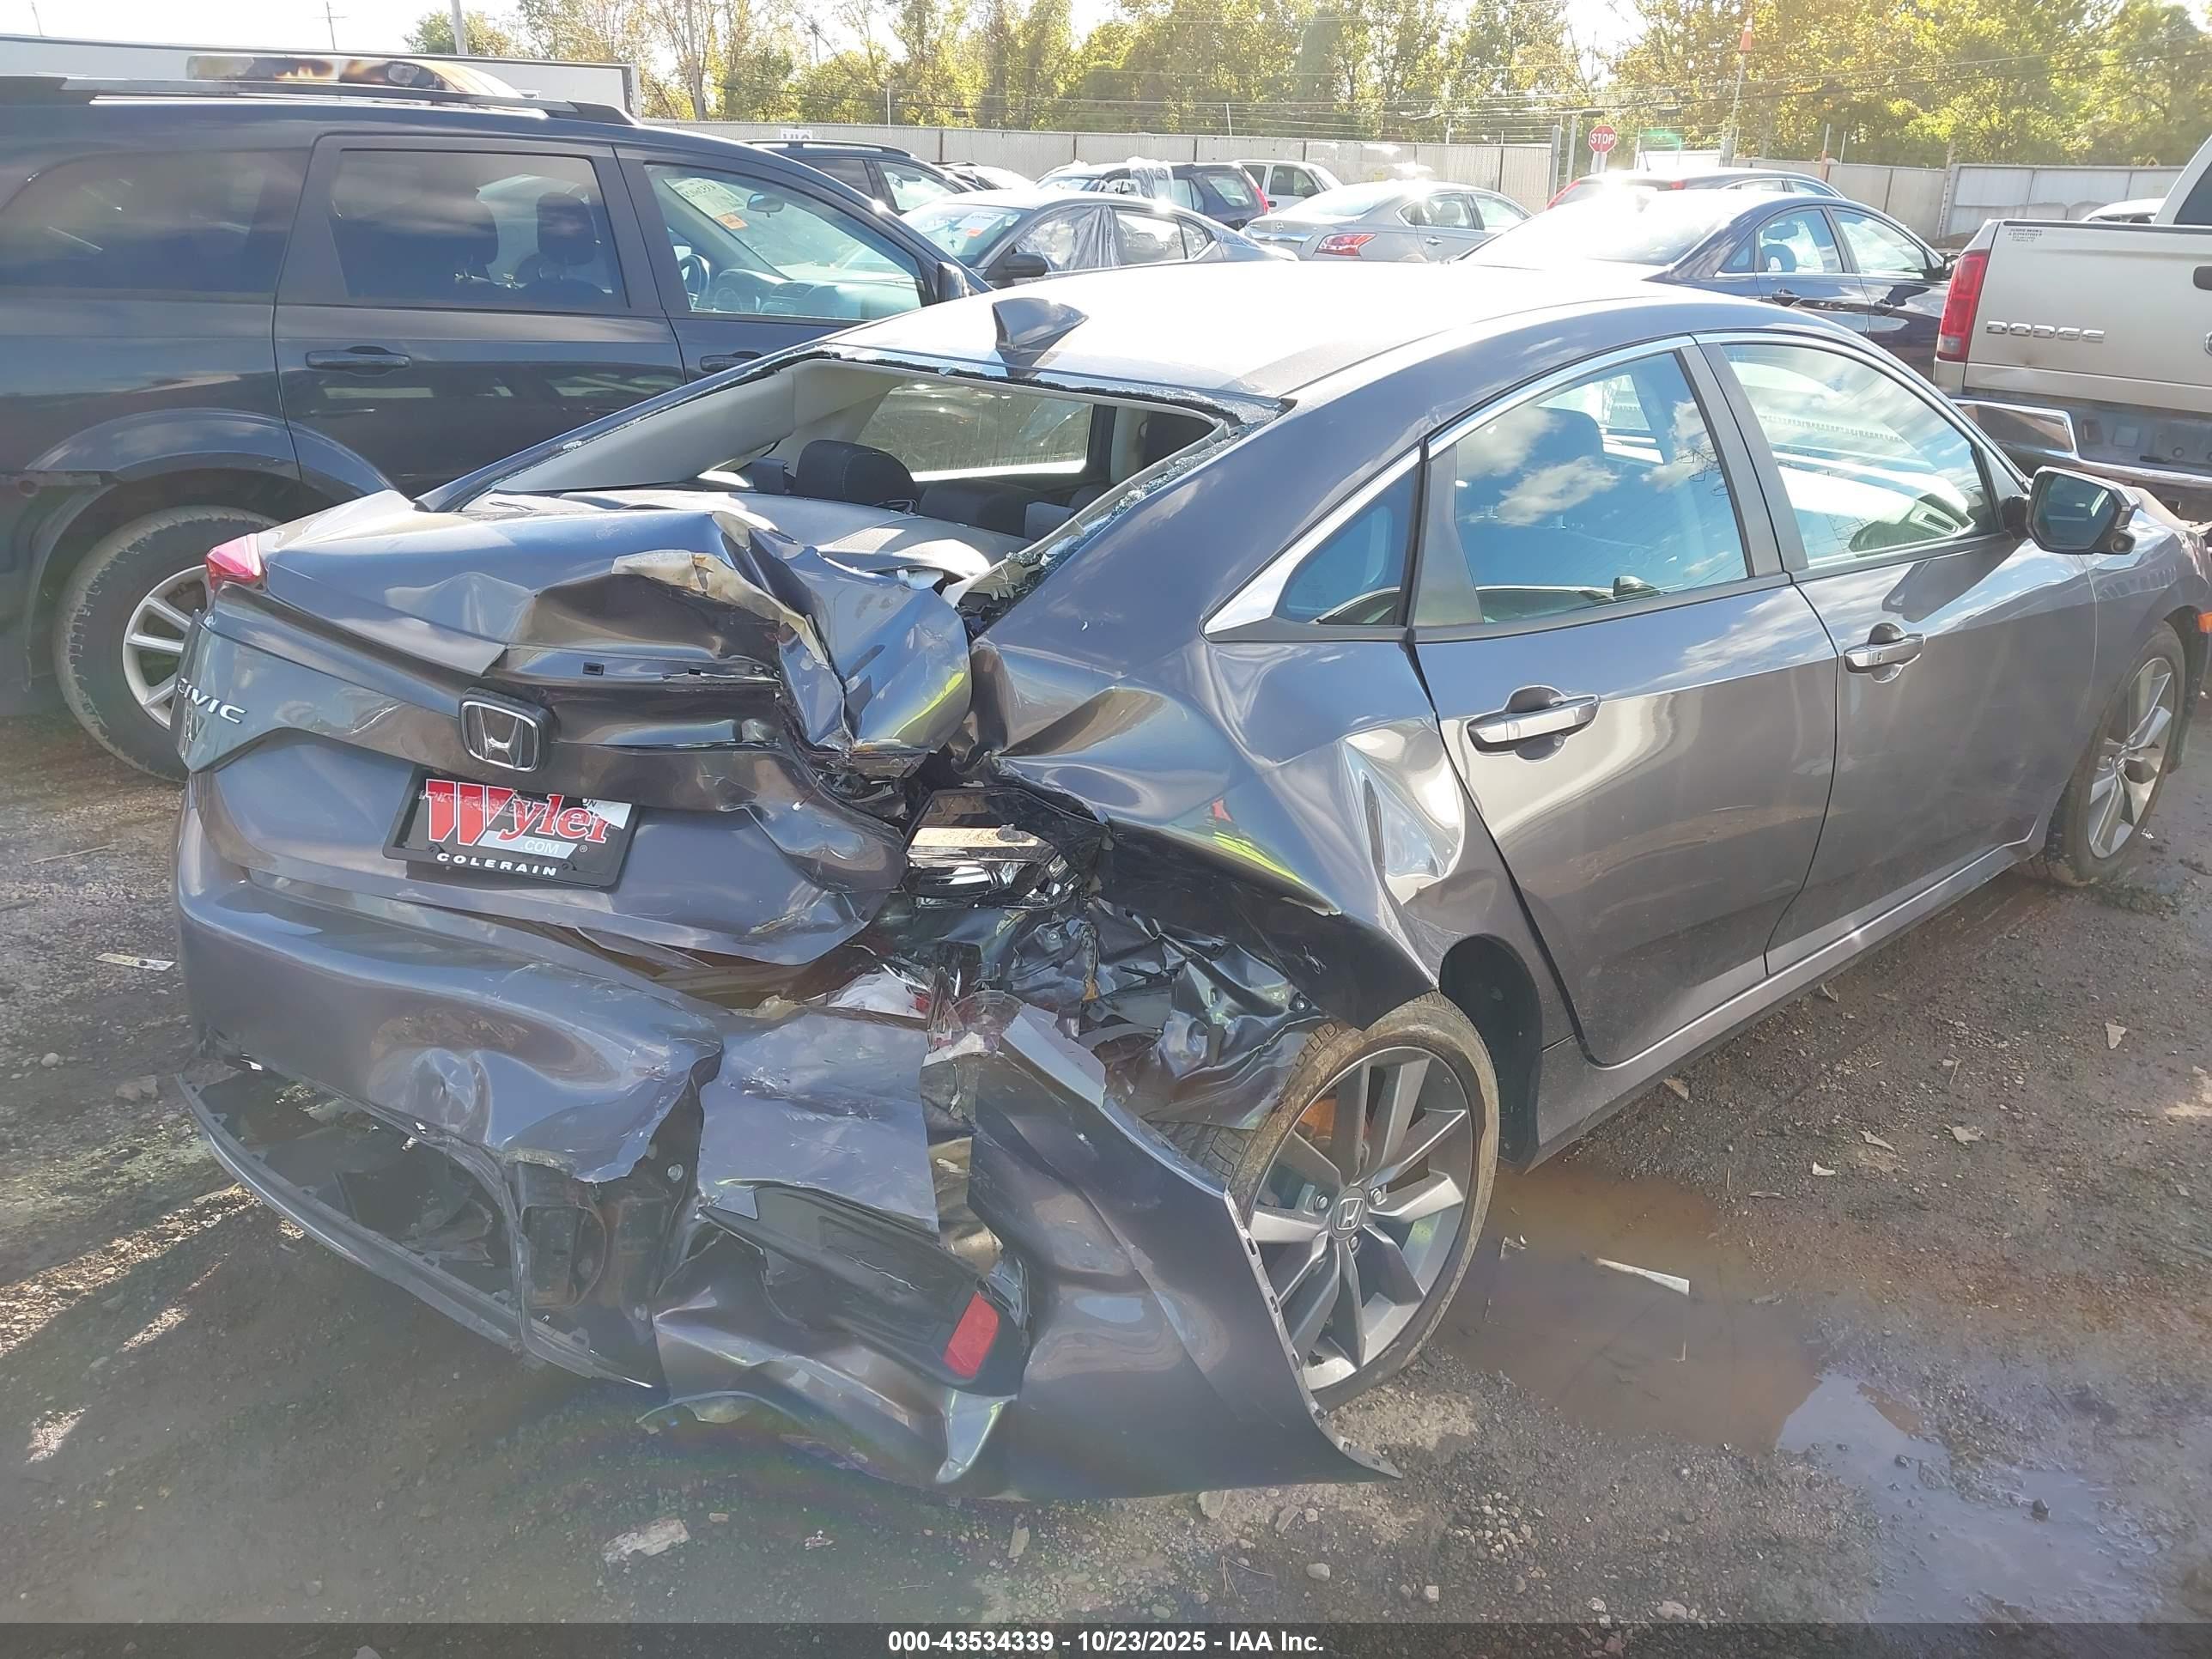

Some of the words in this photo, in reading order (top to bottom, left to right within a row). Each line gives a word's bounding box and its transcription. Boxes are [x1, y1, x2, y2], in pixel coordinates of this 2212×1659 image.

[1590, 132, 1615, 145] STOP
[1986, 320, 2106, 343] DODGE
[177, 677, 247, 724] CIVIC
[425, 778, 611, 847] Wyler
[436, 853, 557, 877] COLERAIN
